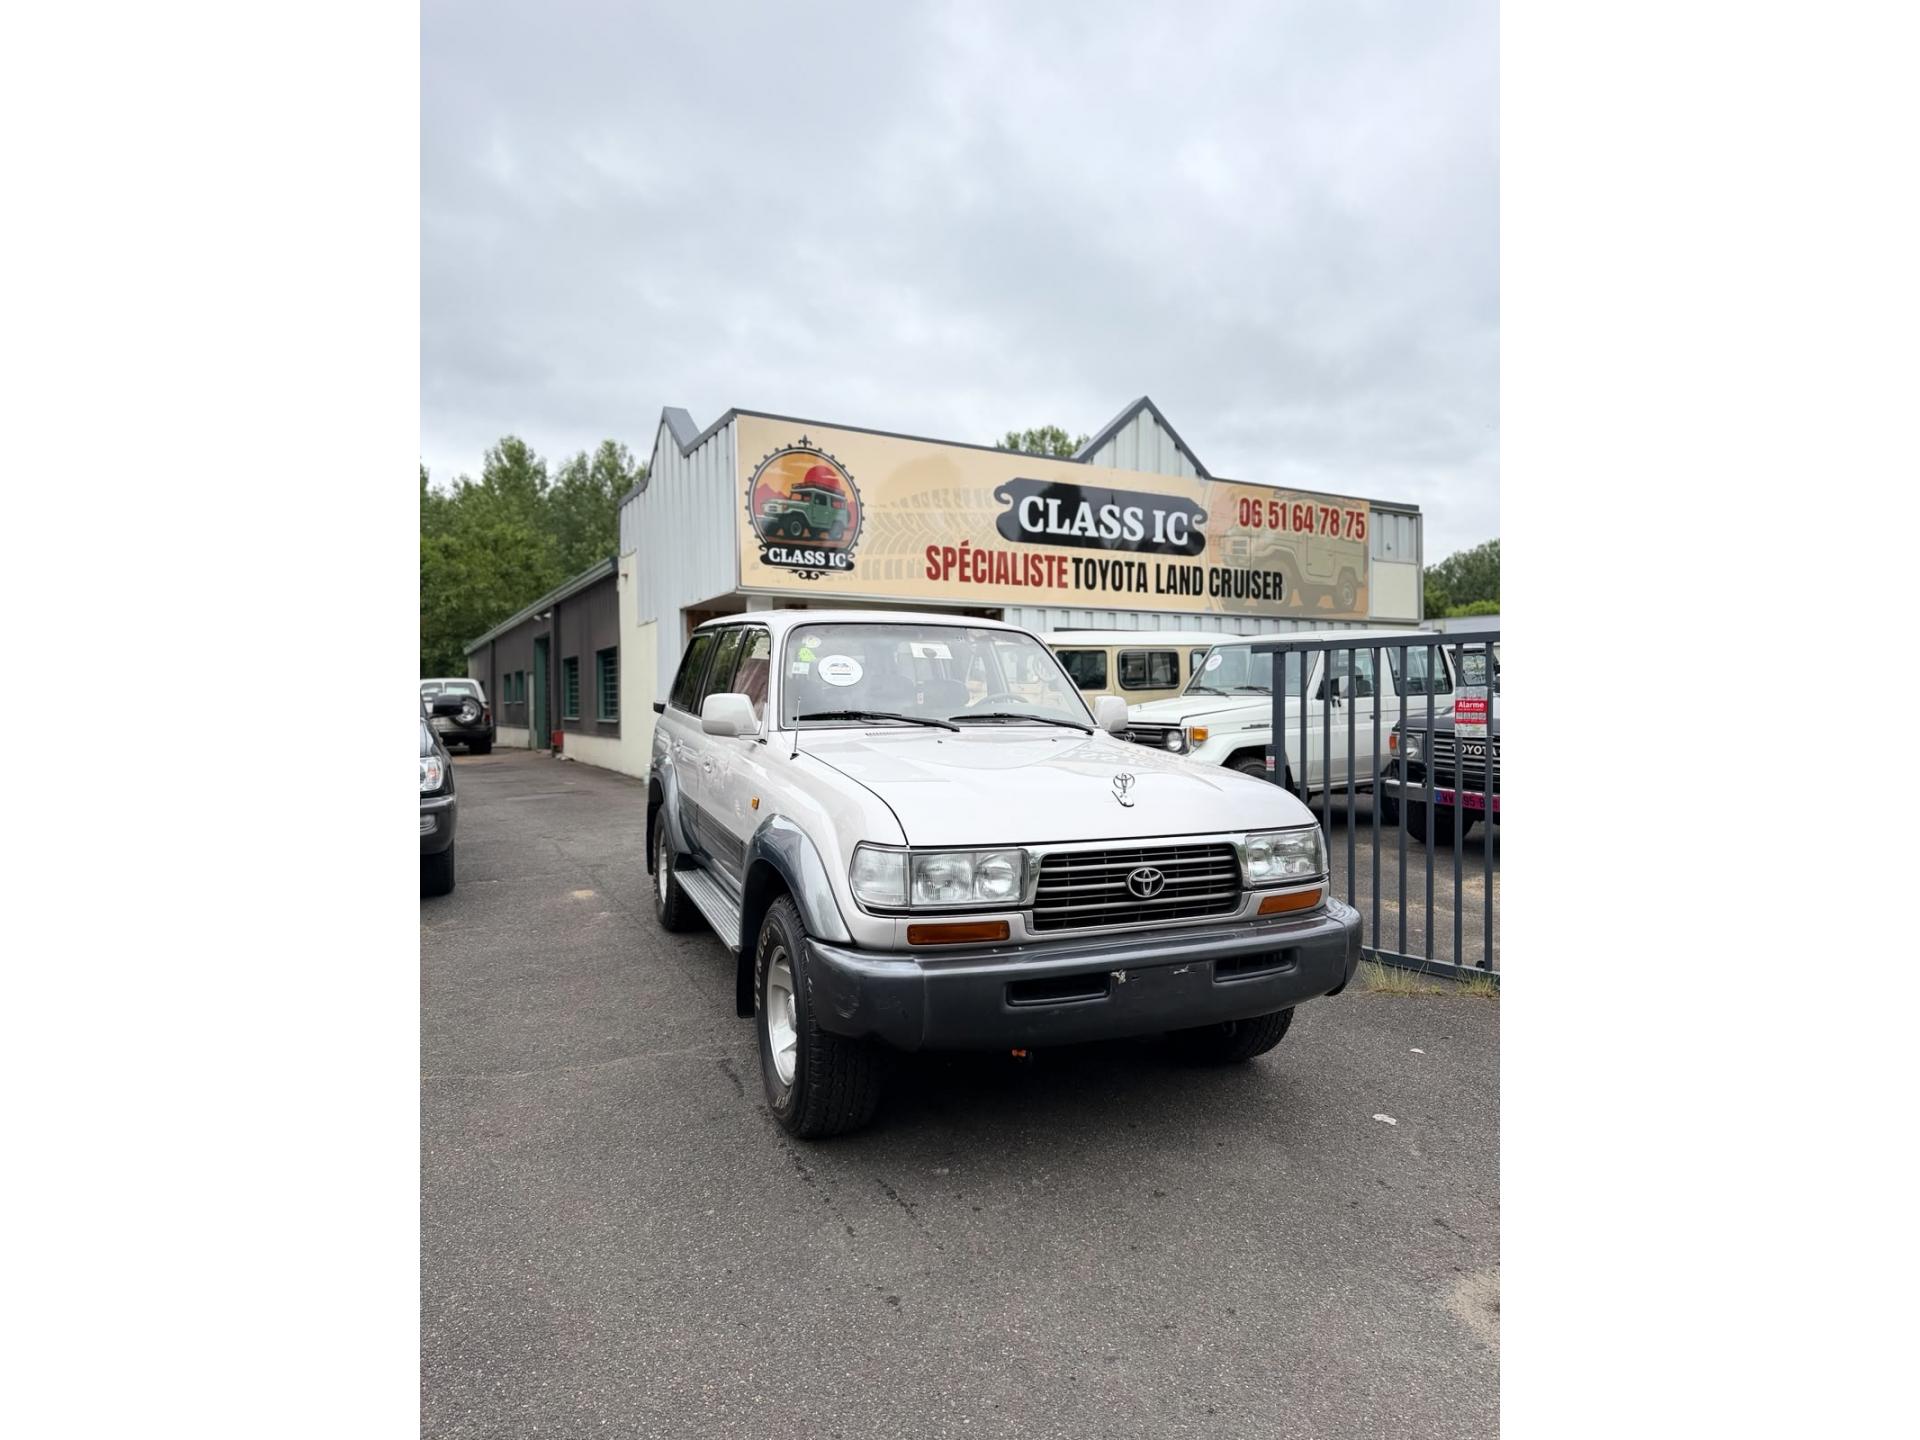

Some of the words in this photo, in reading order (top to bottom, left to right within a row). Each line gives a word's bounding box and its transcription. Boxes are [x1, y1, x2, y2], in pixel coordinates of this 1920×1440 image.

[1019, 495, 1145, 541] CLASS
[1152, 510, 1188, 546] IC
[1239, 498, 1262, 529] 06
[1268, 501, 1286, 530] 51
[1292, 504, 1314, 533] 64
[1319, 507, 1340, 537] 78
[1345, 511, 1365, 539] 75
[768, 547, 826, 566] CLASS
[828, 552, 847, 568] IC
[926, 540, 1068, 589] SPÉCIALISTE
[1072, 557, 1148, 593] TOYOTA
[1155, 563, 1204, 597] LAND
[1209, 567, 1283, 601] CRUISER
[1458, 701, 1485, 709] Alarme
